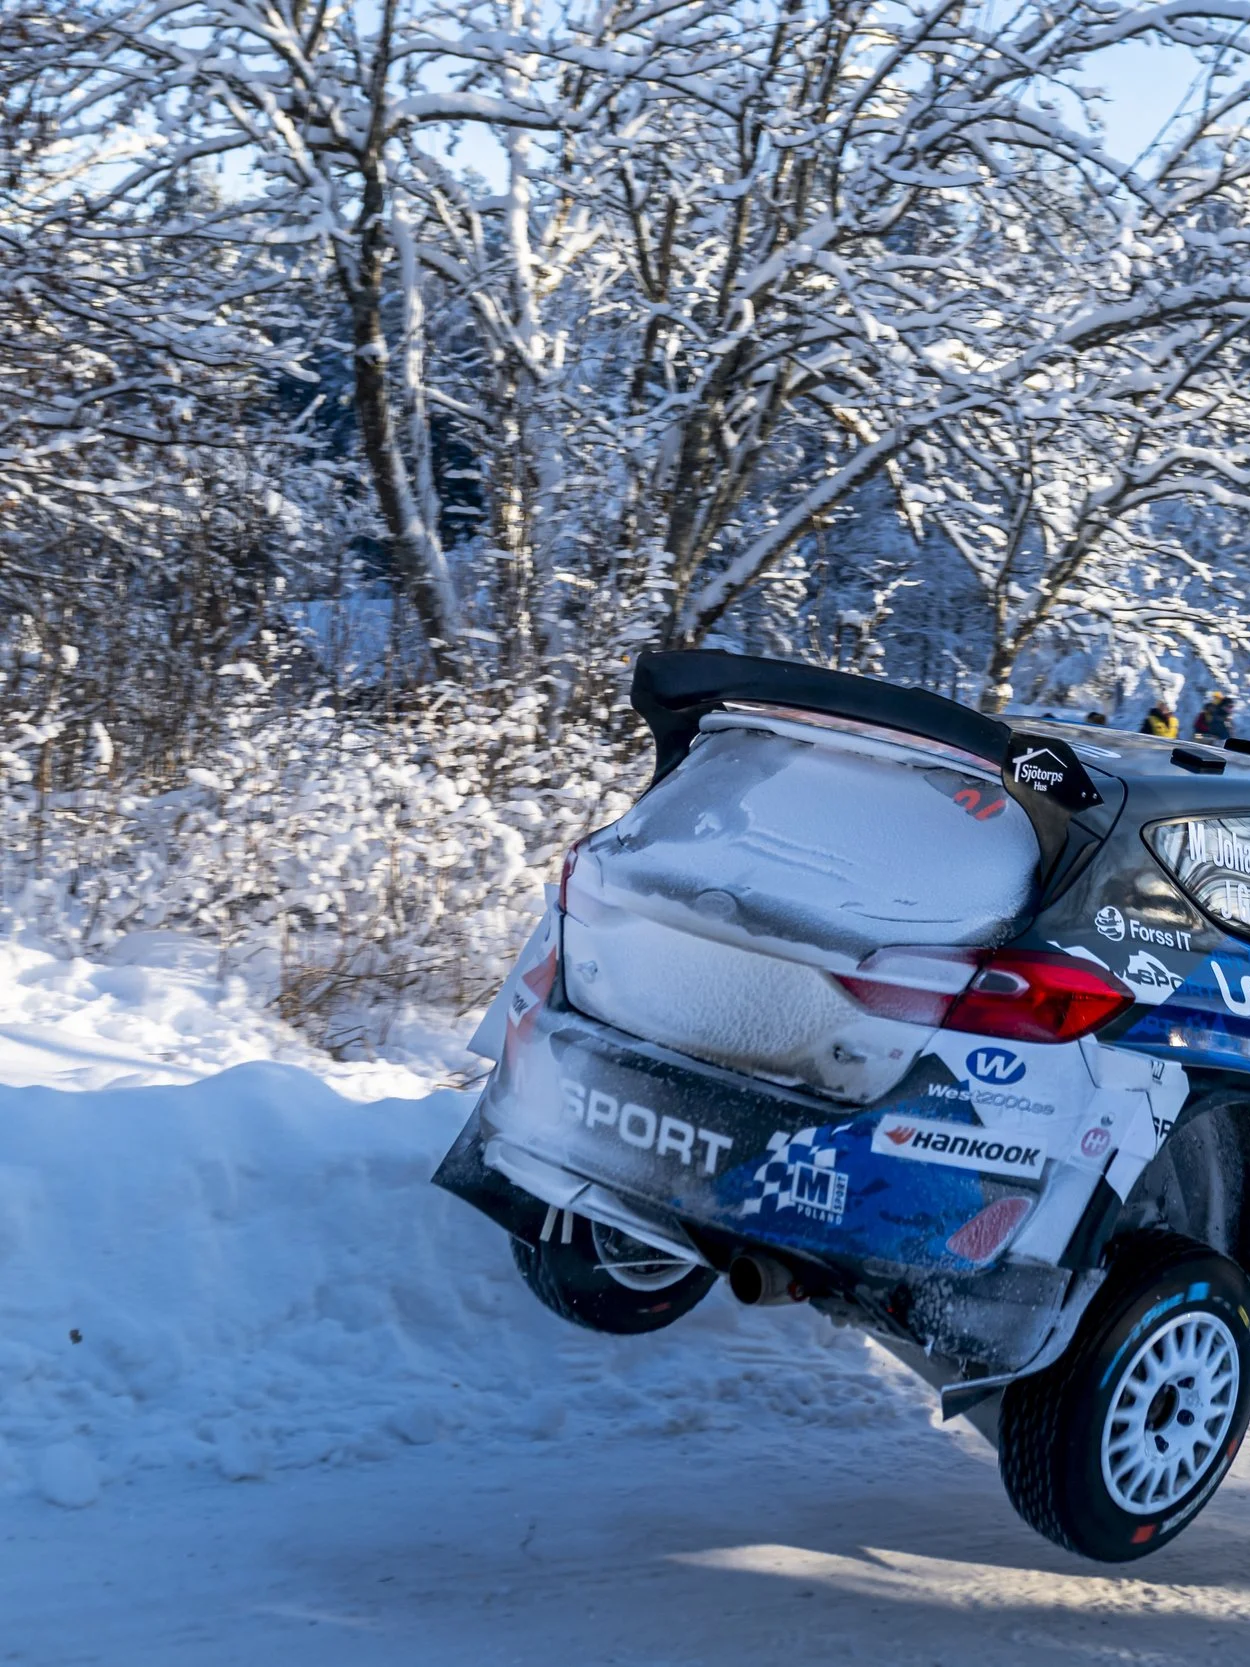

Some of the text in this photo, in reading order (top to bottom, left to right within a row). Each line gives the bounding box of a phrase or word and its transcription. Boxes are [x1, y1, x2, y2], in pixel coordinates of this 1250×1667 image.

[1021, 764, 1063, 786] Sjötorps
[1033, 782, 1047, 792] Hus
[1188, 821, 1206, 862] M
[1221, 880, 1232, 919] J
[1130, 920, 1191, 951] Forss IT
[560, 1078, 733, 1175] SPORT
[797, 1204, 843, 1225] POLAND
